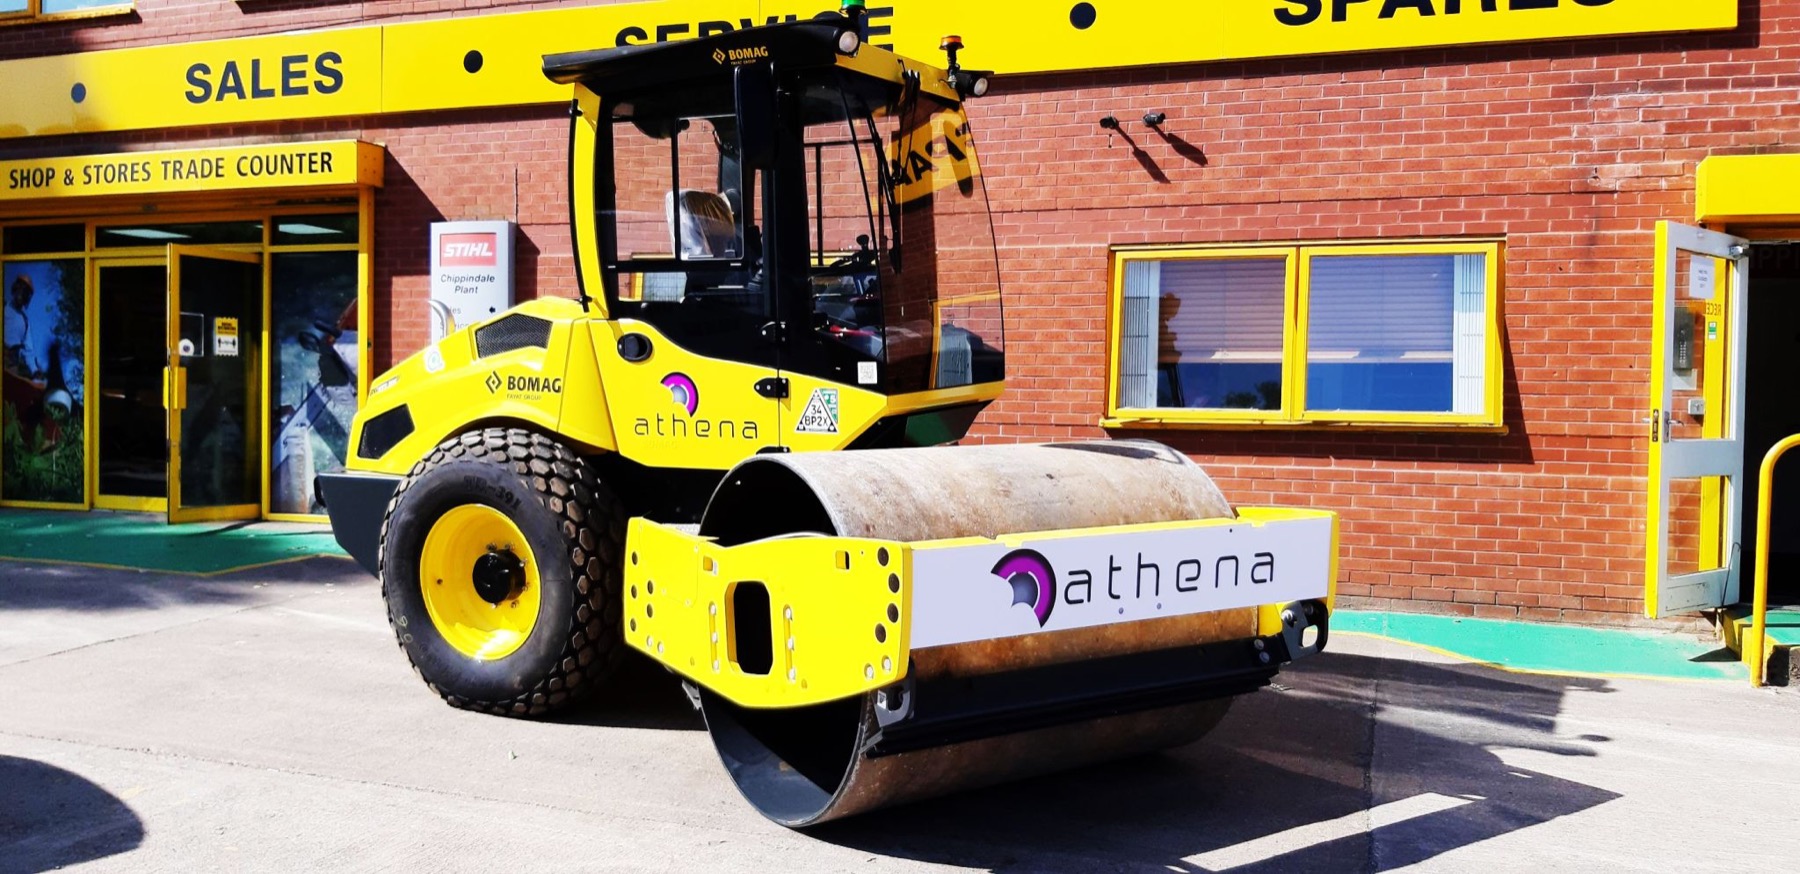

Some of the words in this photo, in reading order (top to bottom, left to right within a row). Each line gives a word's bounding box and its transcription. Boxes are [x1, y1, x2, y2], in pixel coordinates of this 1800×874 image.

[728, 46, 769, 61] BOMAG
[185, 51, 344, 104] SALES
[9, 167, 56, 189] SHOP
[63, 168, 75, 186] &
[83, 161, 151, 185] STORES
[161, 157, 225, 181] TRADE
[236, 152, 333, 177] COUNTER
[444, 242, 493, 258] STIHL
[440, 274, 495, 283] Chippindale
[454, 285, 478, 294] Plant
[507, 375, 562, 394] BOMAG
[811, 404, 822, 415] 34
[634, 413, 758, 439] athena
[1064, 551, 1274, 605] athena
